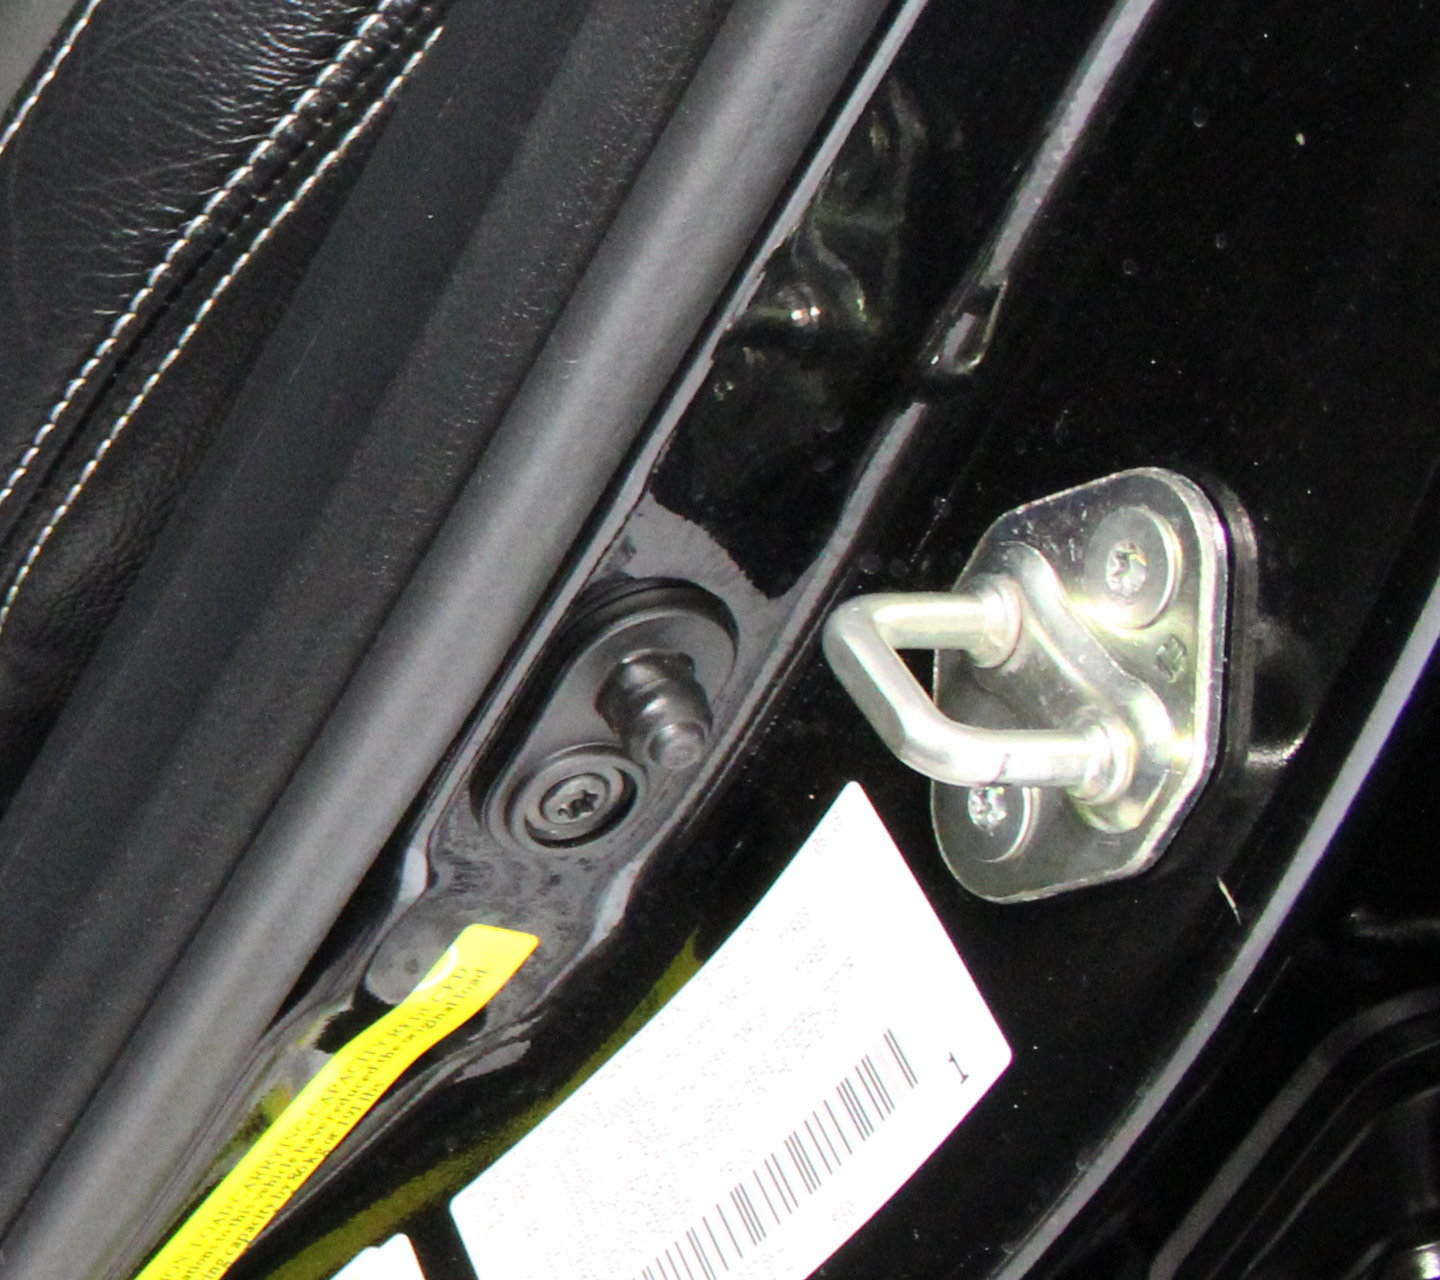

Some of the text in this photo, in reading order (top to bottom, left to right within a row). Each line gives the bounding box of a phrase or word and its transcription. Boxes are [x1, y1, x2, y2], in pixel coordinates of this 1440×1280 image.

[213, 1227, 233, 1243] to
[225, 1201, 257, 1228] this
[249, 1154, 299, 1201] vehicle
[292, 1121, 330, 1154] have
[320, 1064, 380, 1121] reduced
[372, 1041, 402, 1064] the
[399, 1001, 458, 1044] original
[451, 967, 489, 999] load
[948, 1051, 969, 1084] 1
[218, 1199, 282, 1258] capacity
[268, 1182, 298, 1202] by
[320, 1130, 340, 1145] or
